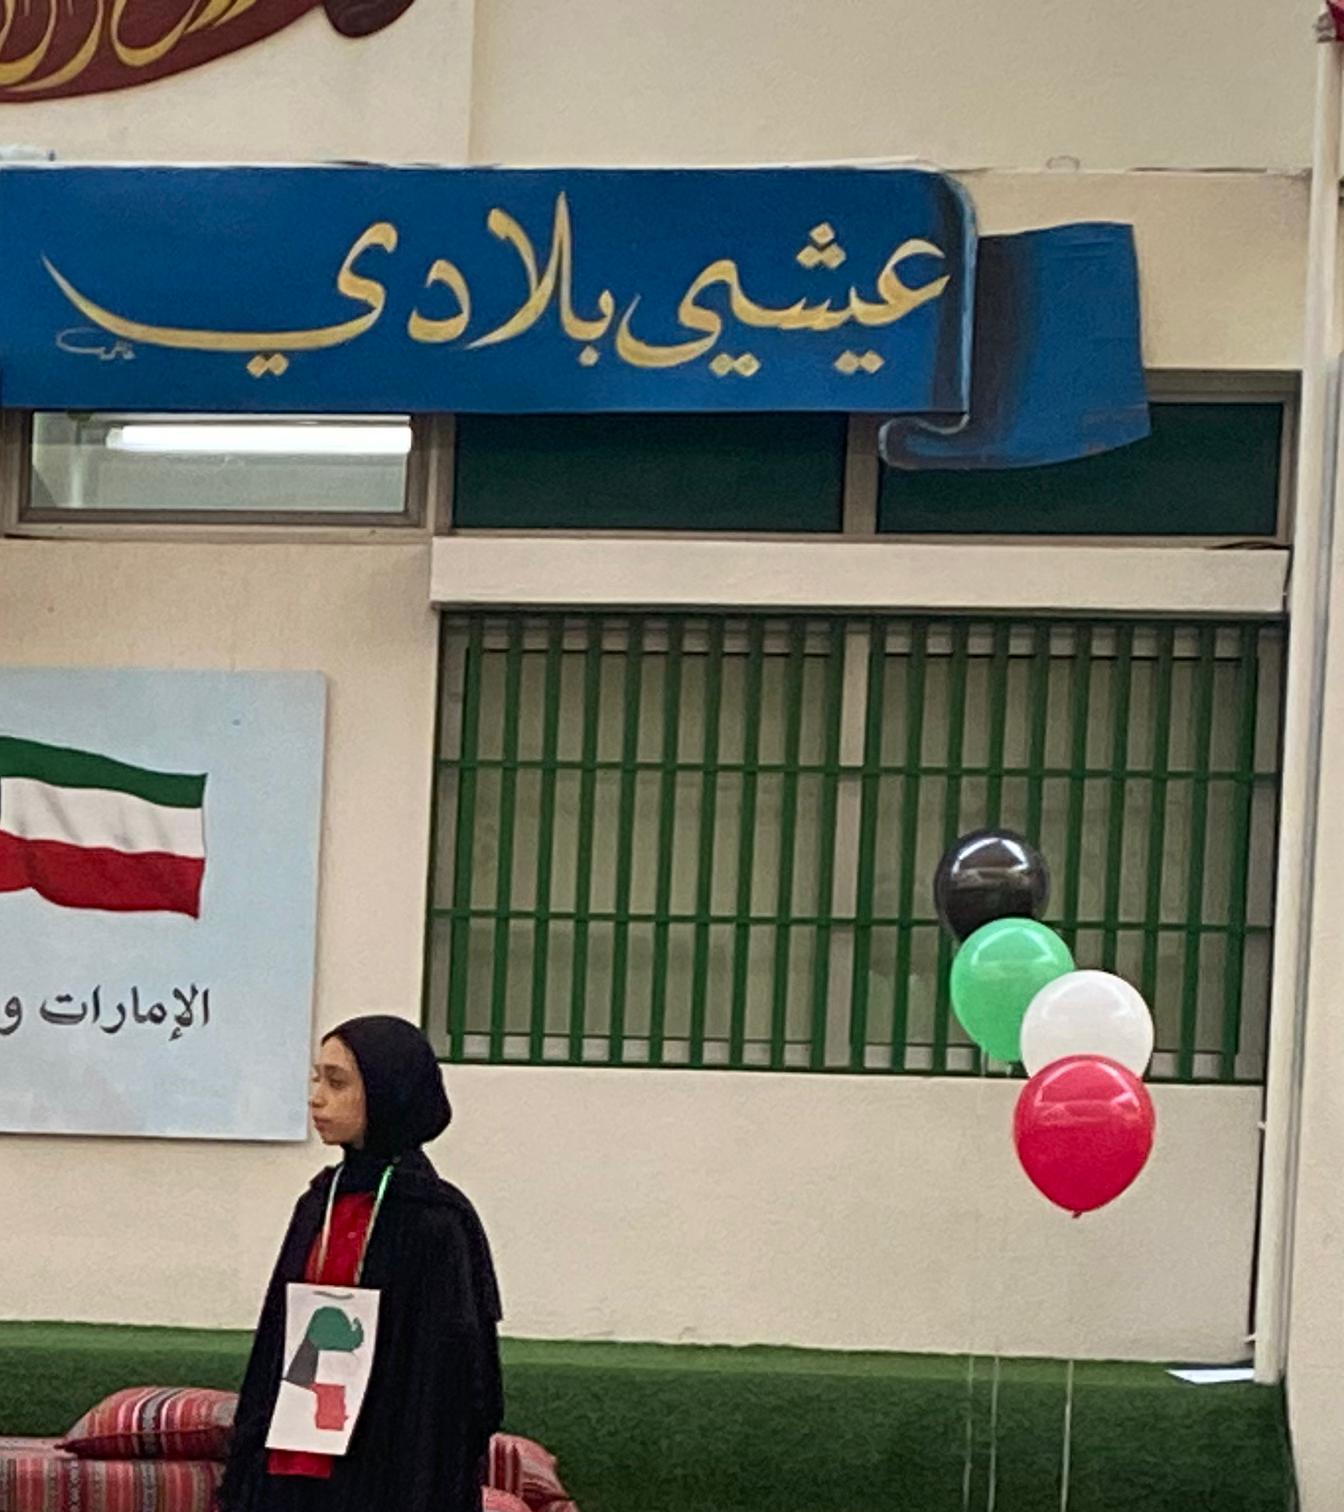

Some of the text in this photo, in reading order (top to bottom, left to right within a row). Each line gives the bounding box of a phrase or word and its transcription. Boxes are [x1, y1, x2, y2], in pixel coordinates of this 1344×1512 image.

[40, 189, 617, 378] بلادي
[615, 221, 953, 378] عيشي
[38, 982, 211, 1043] الإمارات
